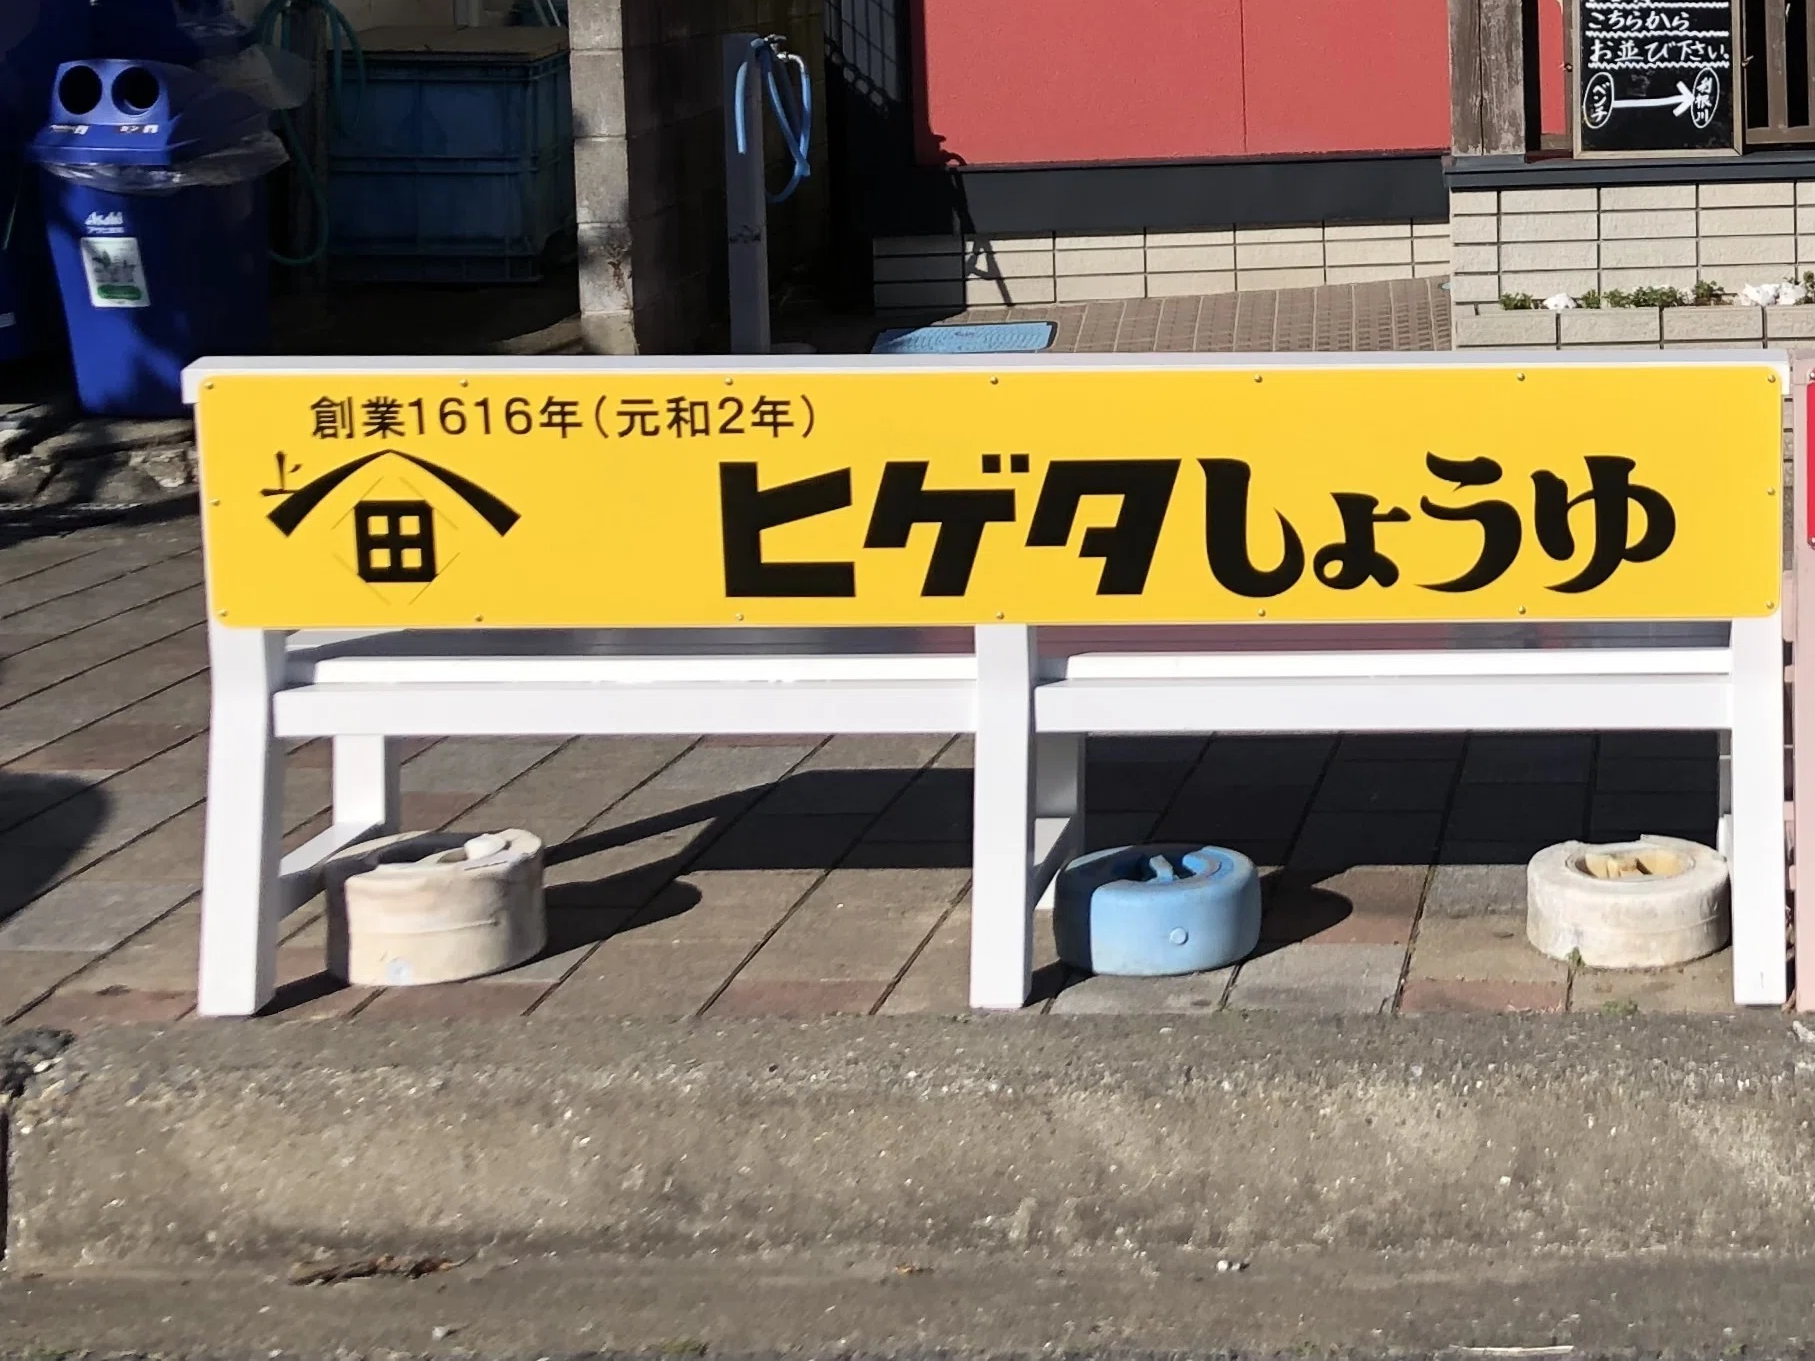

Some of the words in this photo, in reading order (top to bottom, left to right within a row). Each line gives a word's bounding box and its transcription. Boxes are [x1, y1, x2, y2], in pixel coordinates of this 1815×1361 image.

[1588, 10, 1690, 31] こちらから
[1591, 82, 1610, 123] ベンチ
[1695, 77, 1712, 123] 利根川
[718, 451, 1677, 599] ヒゲタしょうゆ
